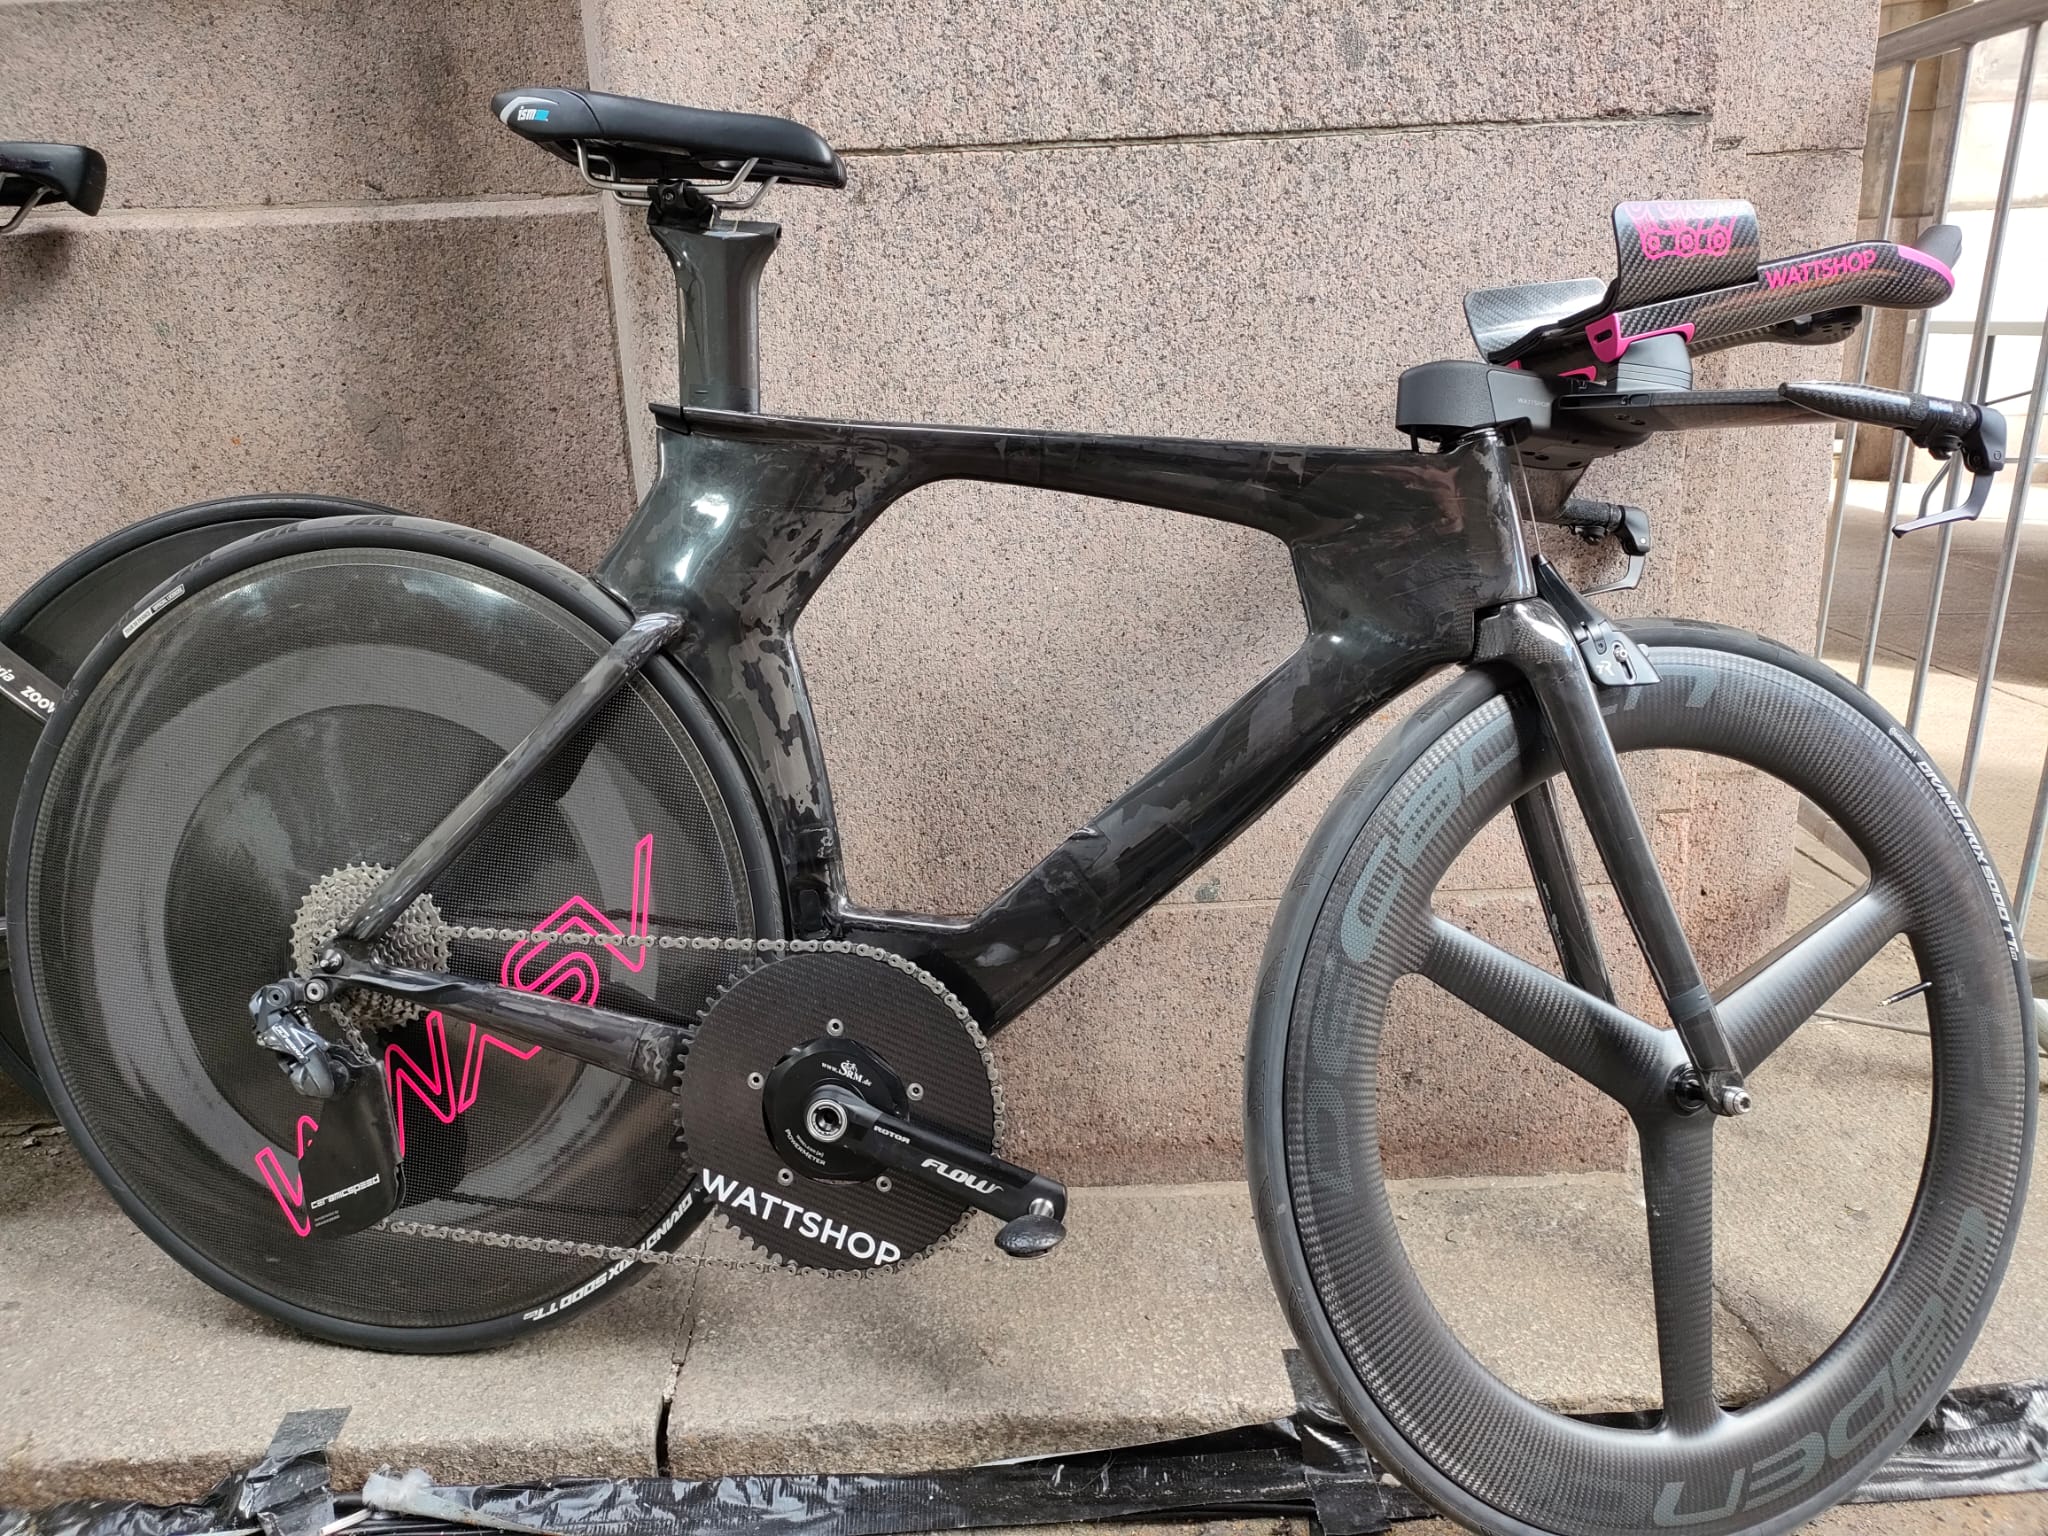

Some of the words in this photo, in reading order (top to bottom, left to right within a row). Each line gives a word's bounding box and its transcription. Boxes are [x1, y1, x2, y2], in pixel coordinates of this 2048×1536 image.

[1764, 250, 1877, 289] WATTSHOP
[1916, 760, 1961, 819] GRAND
[1957, 819, 1988, 866] PRIX
[1981, 864, 2011, 920] 5000
[784, 1129, 826, 1166] POWERMETER
[873, 1125, 911, 1145] ROTOR
[310, 1173, 380, 1210] ceramicspeed
[920, 1157, 1004, 1195] FLOW
[646, 1192, 693, 1251] GRAND
[702, 1168, 901, 1266] WATTSHOP
[559, 1271, 608, 1310] 5000
